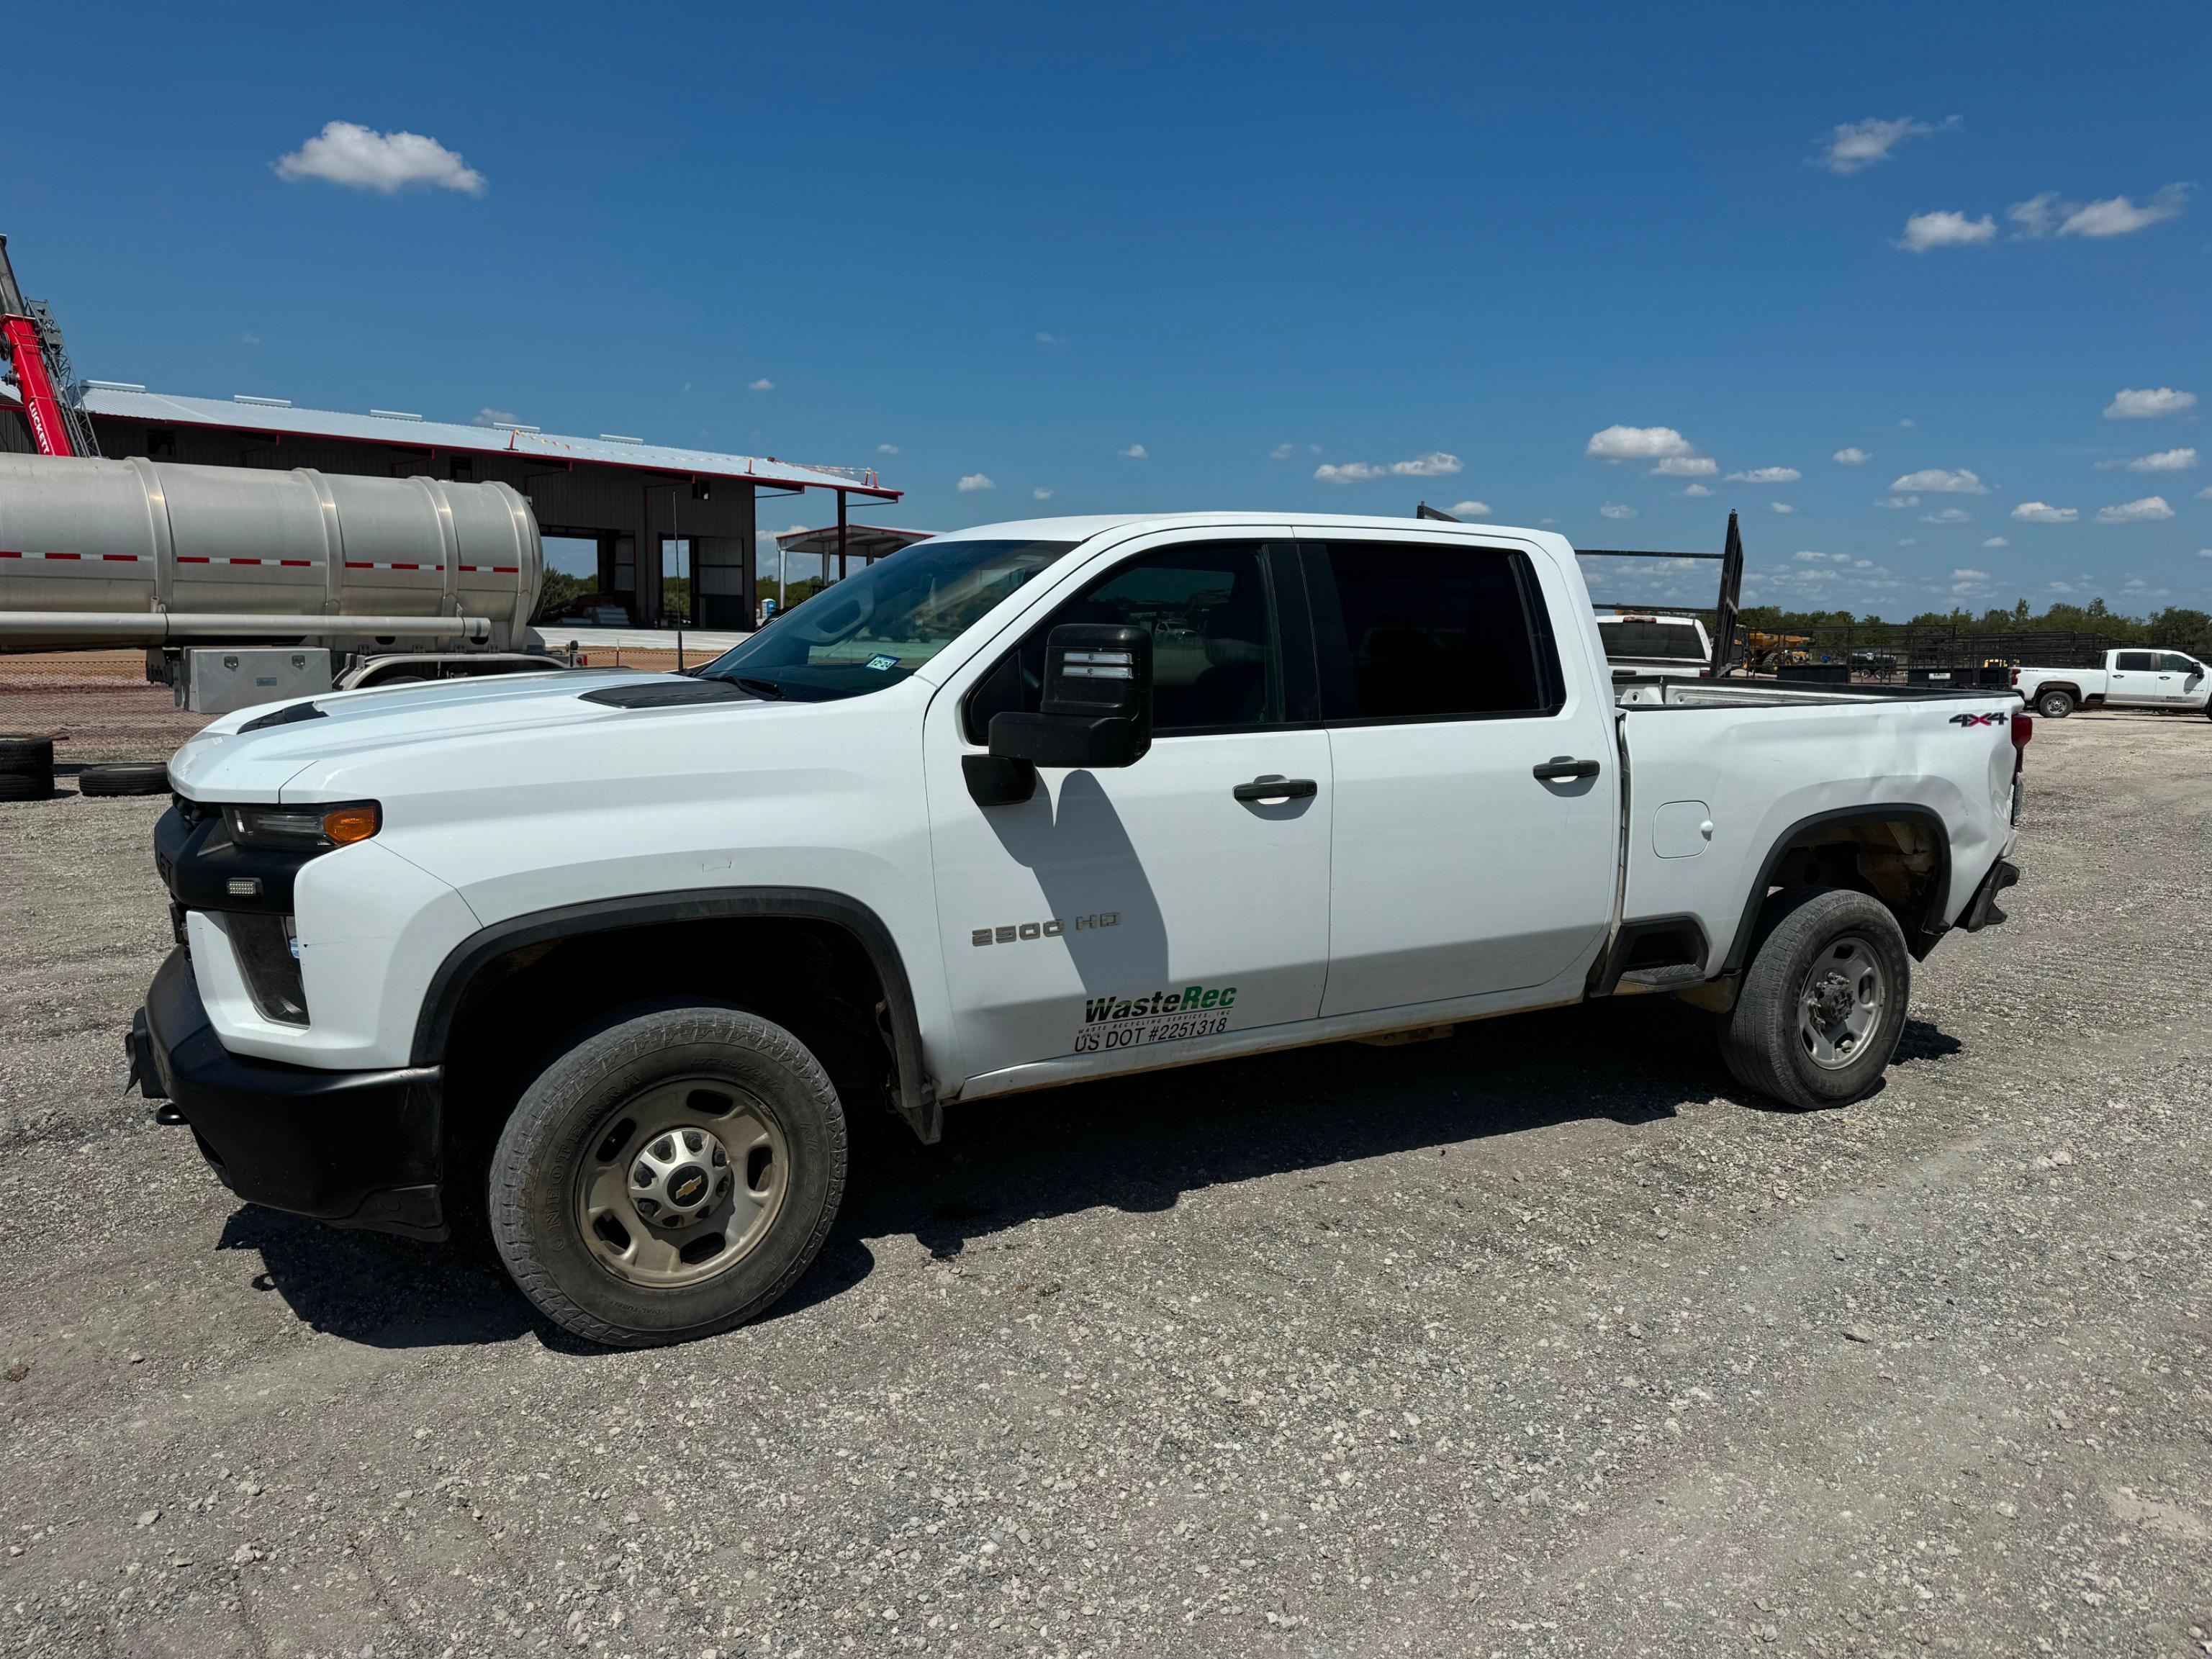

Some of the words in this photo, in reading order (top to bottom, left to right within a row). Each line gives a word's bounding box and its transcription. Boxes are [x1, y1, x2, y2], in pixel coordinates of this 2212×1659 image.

[30, 402, 50, 454] LUCKETT
[972, 919, 1064, 946] 2500
[1076, 912, 1121, 931] HD
[1085, 986, 1237, 1023] WasteRec
[1075, 1034, 1100, 1052] US
[1106, 1028, 1145, 1049] DOT
[1148, 1018, 1227, 1042] #2251318
[1078, 1024, 1107, 1034] WASTE
[1113, 1017, 1162, 1029] RECYCLING
